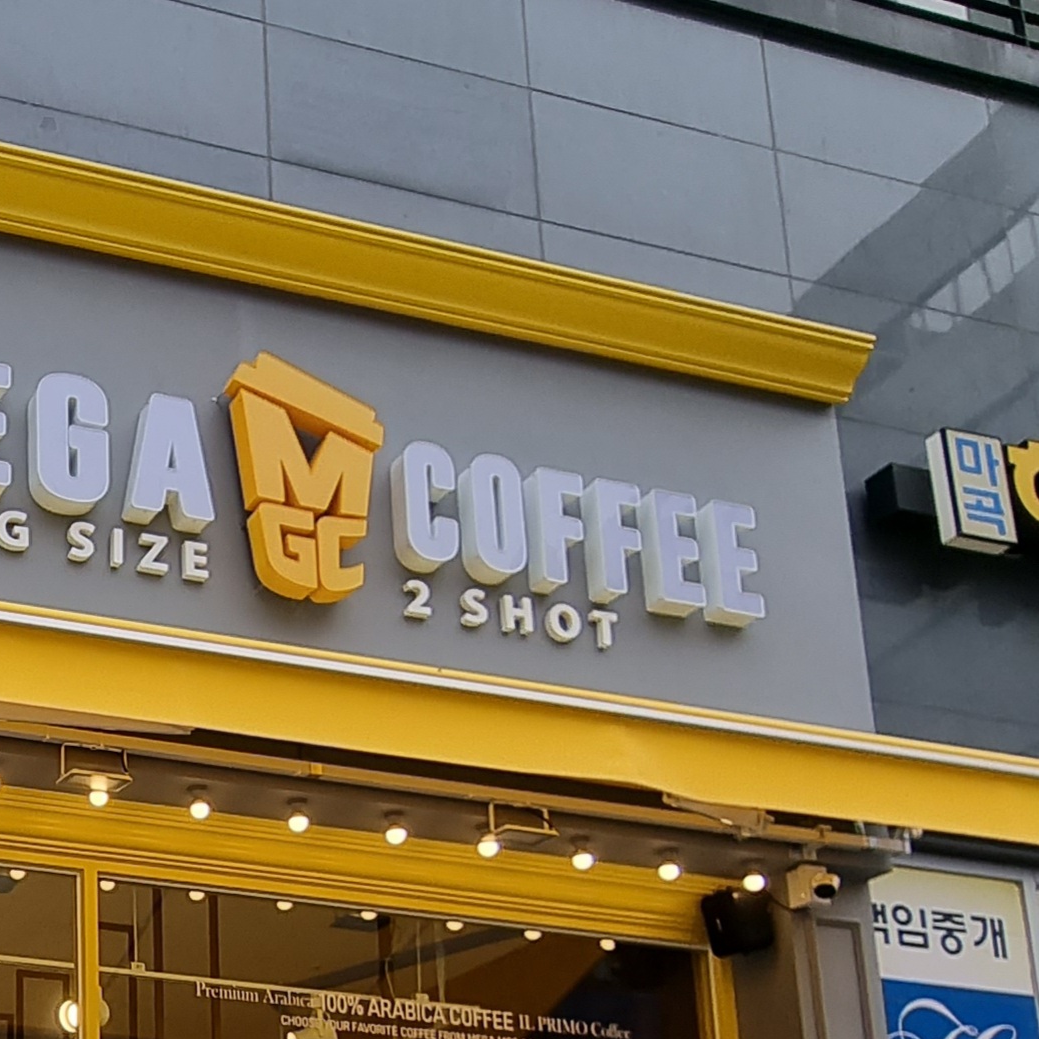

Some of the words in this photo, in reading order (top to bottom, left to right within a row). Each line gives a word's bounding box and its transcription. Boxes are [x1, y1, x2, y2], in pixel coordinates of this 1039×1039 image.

[66, 520, 210, 585] SIZE
[390, 440, 766, 628] COFFEE
[402, 578, 433, 621] 2
[459, 588, 618, 651] SHOT
[195, 980, 259, 1003] Premium
[319, 992, 364, 1016] 100%
[367, 997, 448, 1025] ARABICA
[449, 1005, 515, 1032] COFFEE
[537, 1015, 588, 1036] PRIMO
[351, 1021, 399, 1037] FAVORITE
